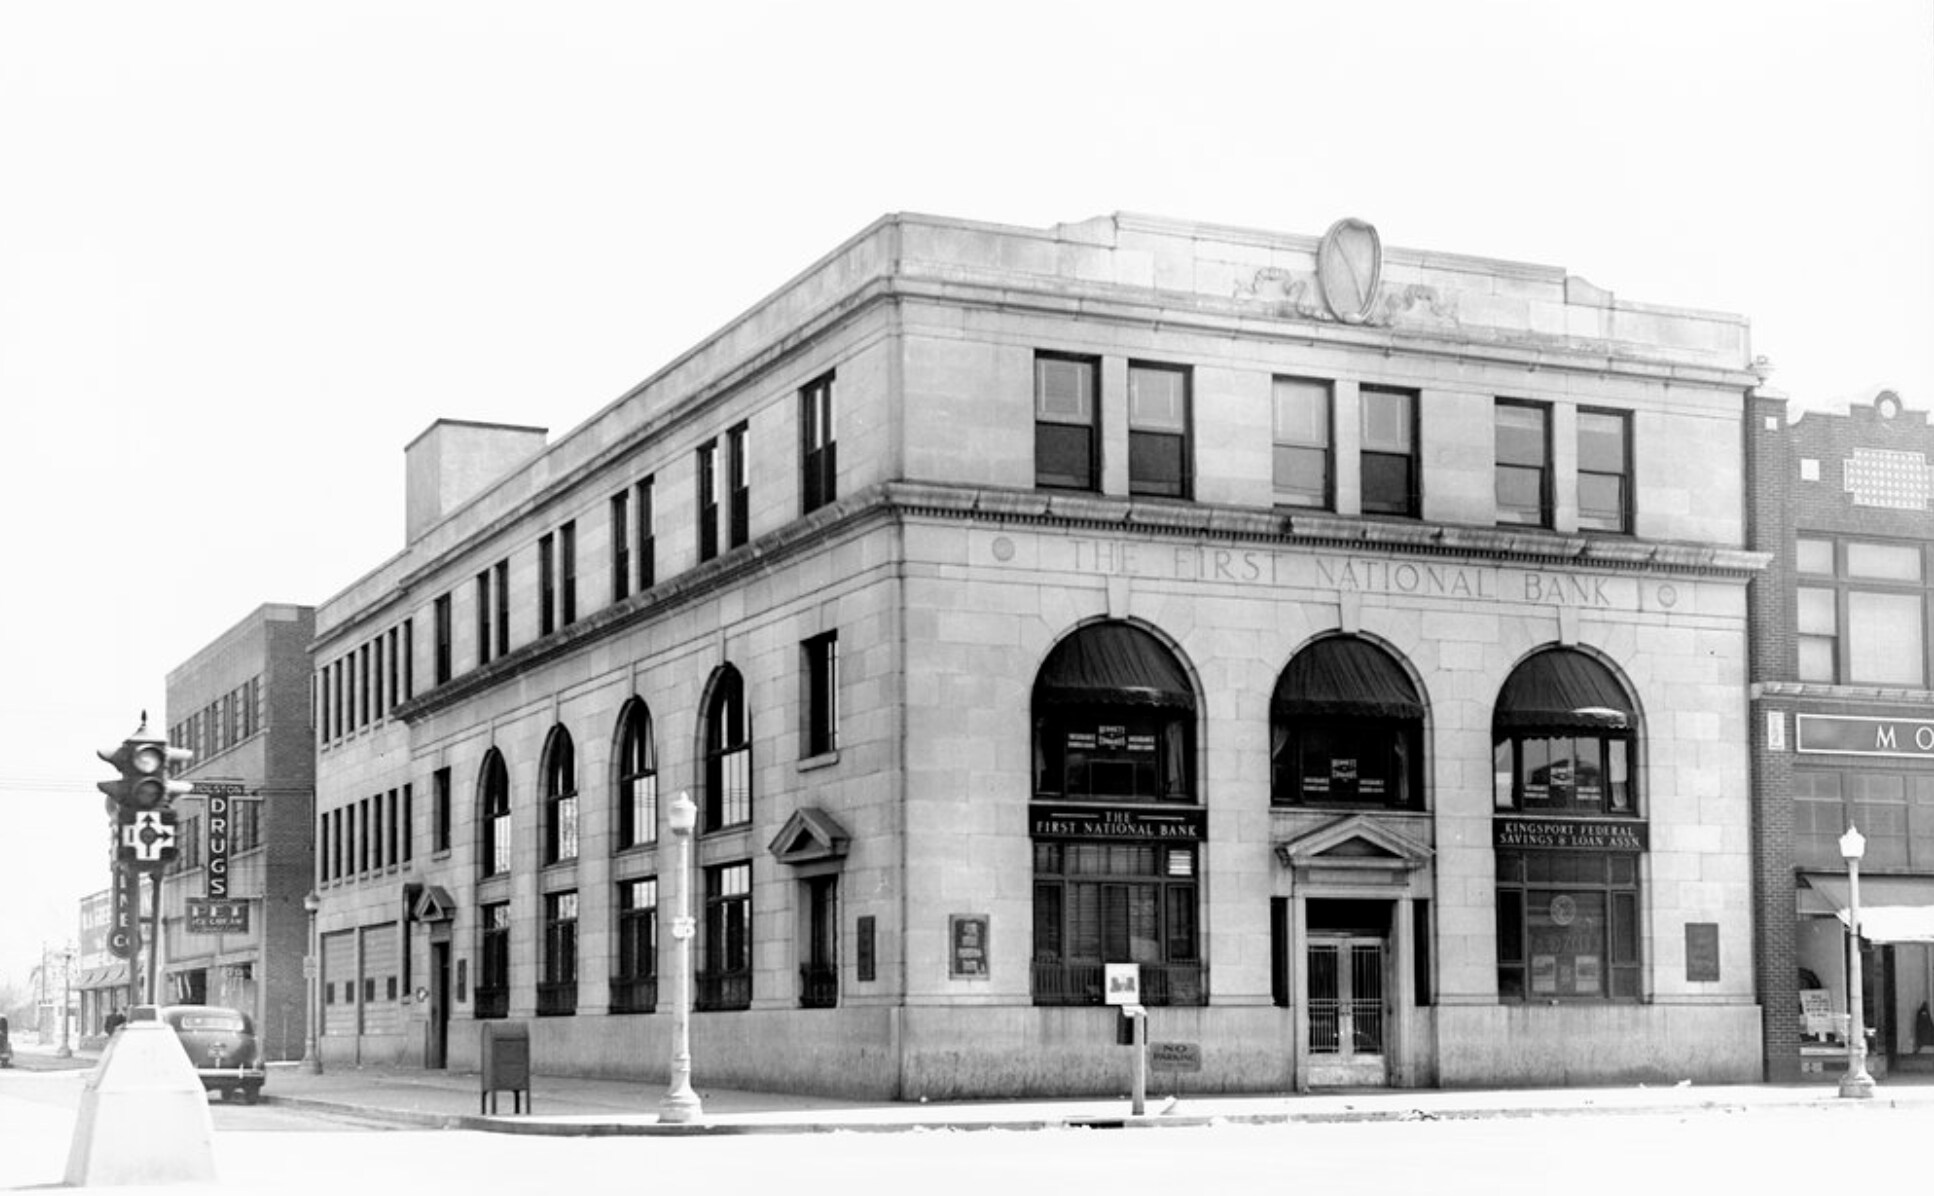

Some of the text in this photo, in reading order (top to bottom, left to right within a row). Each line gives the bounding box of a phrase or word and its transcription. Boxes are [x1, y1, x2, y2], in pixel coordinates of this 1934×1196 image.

[1070, 539, 1611, 606] THE FIRST NATIONAL BANK
[1105, 811, 1130, 824] THE
[1036, 820, 1198, 838] FIRST NATIONAL BANK
[1504, 822, 1635, 837] KINGSPORT FEDERAL
[211, 798, 226, 894] DRUGS
[1499, 832, 1554, 845] SAVINGS
[1571, 835, 1604, 846] LOAN
[1163, 1044, 1188, 1053] NO
